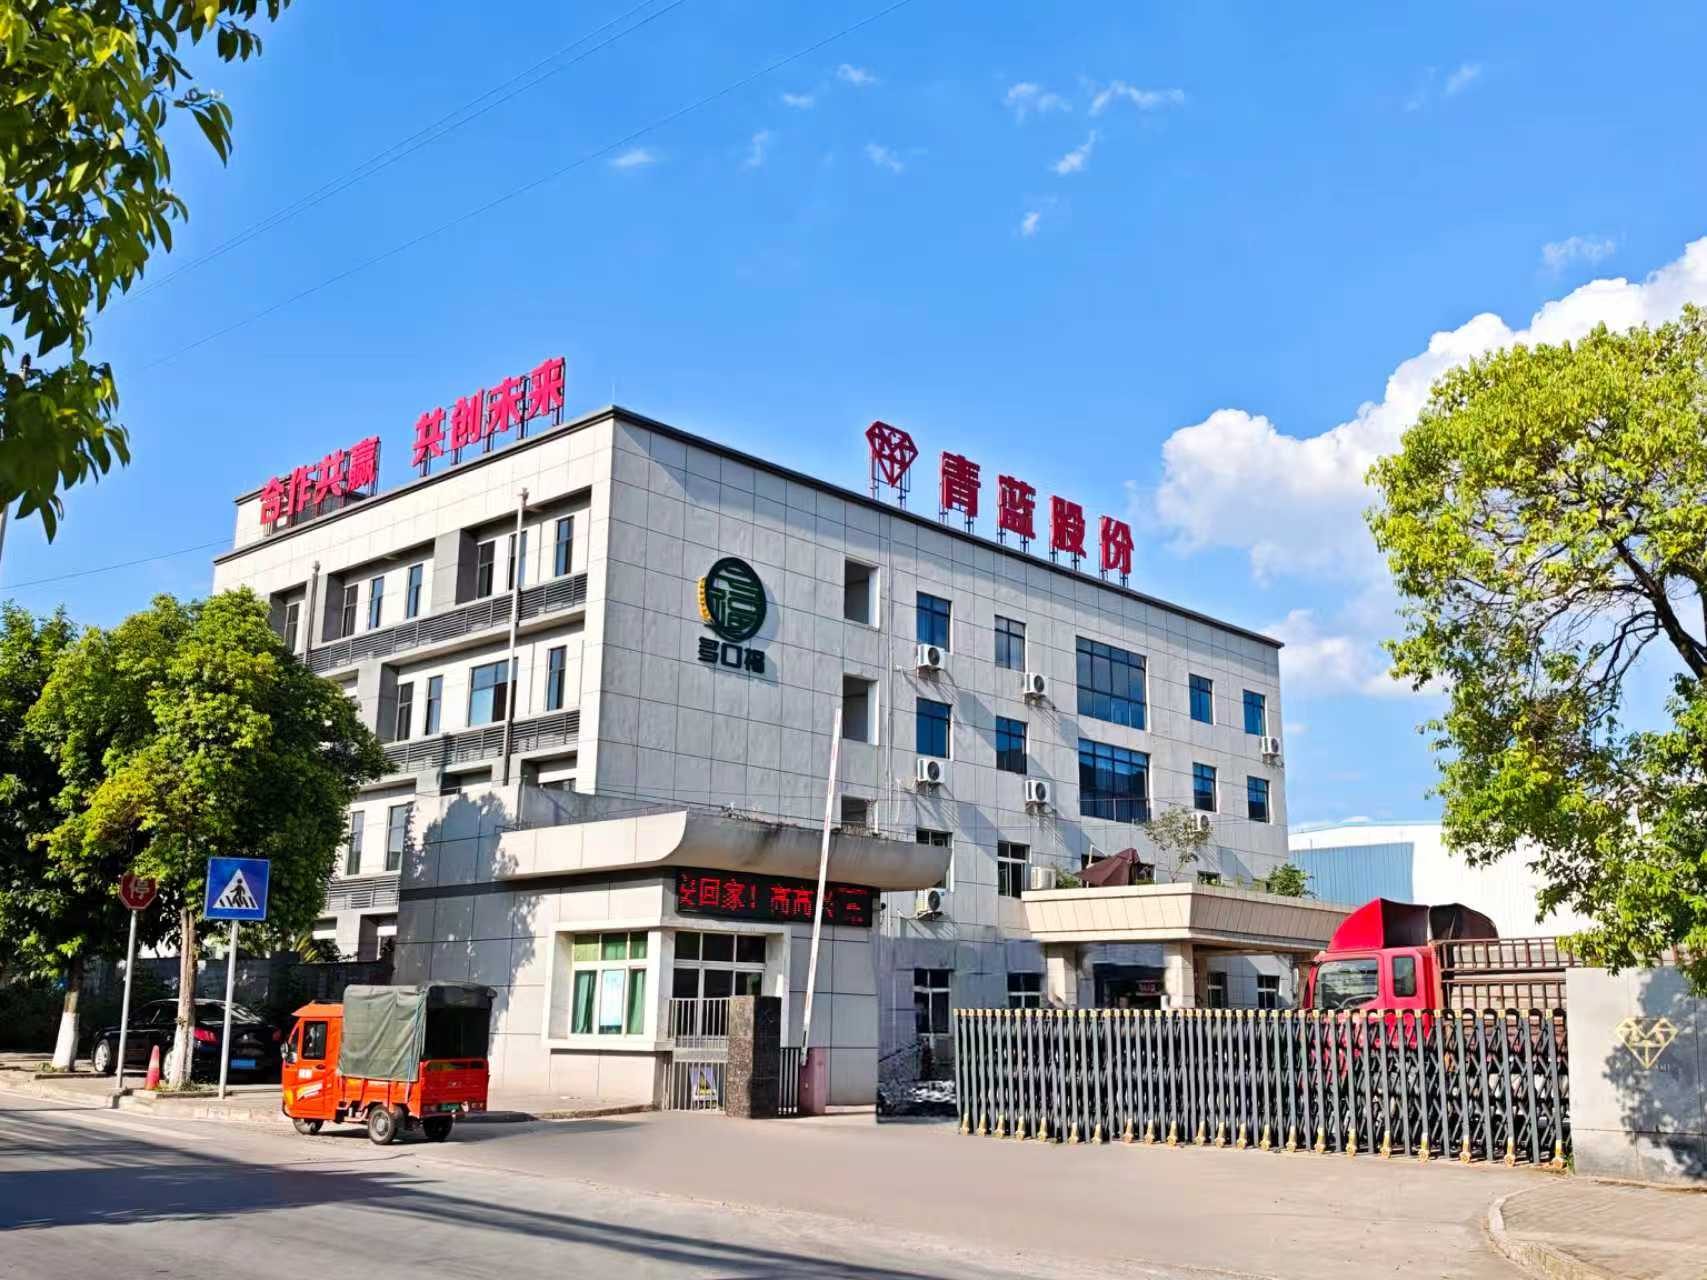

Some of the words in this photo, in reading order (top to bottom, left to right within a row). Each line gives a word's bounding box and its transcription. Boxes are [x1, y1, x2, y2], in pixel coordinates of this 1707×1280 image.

[260, 435, 380, 525] 合作共赢
[411, 356, 566, 467] 共创未来
[942, 451, 1134, 575] 青蓝股份
